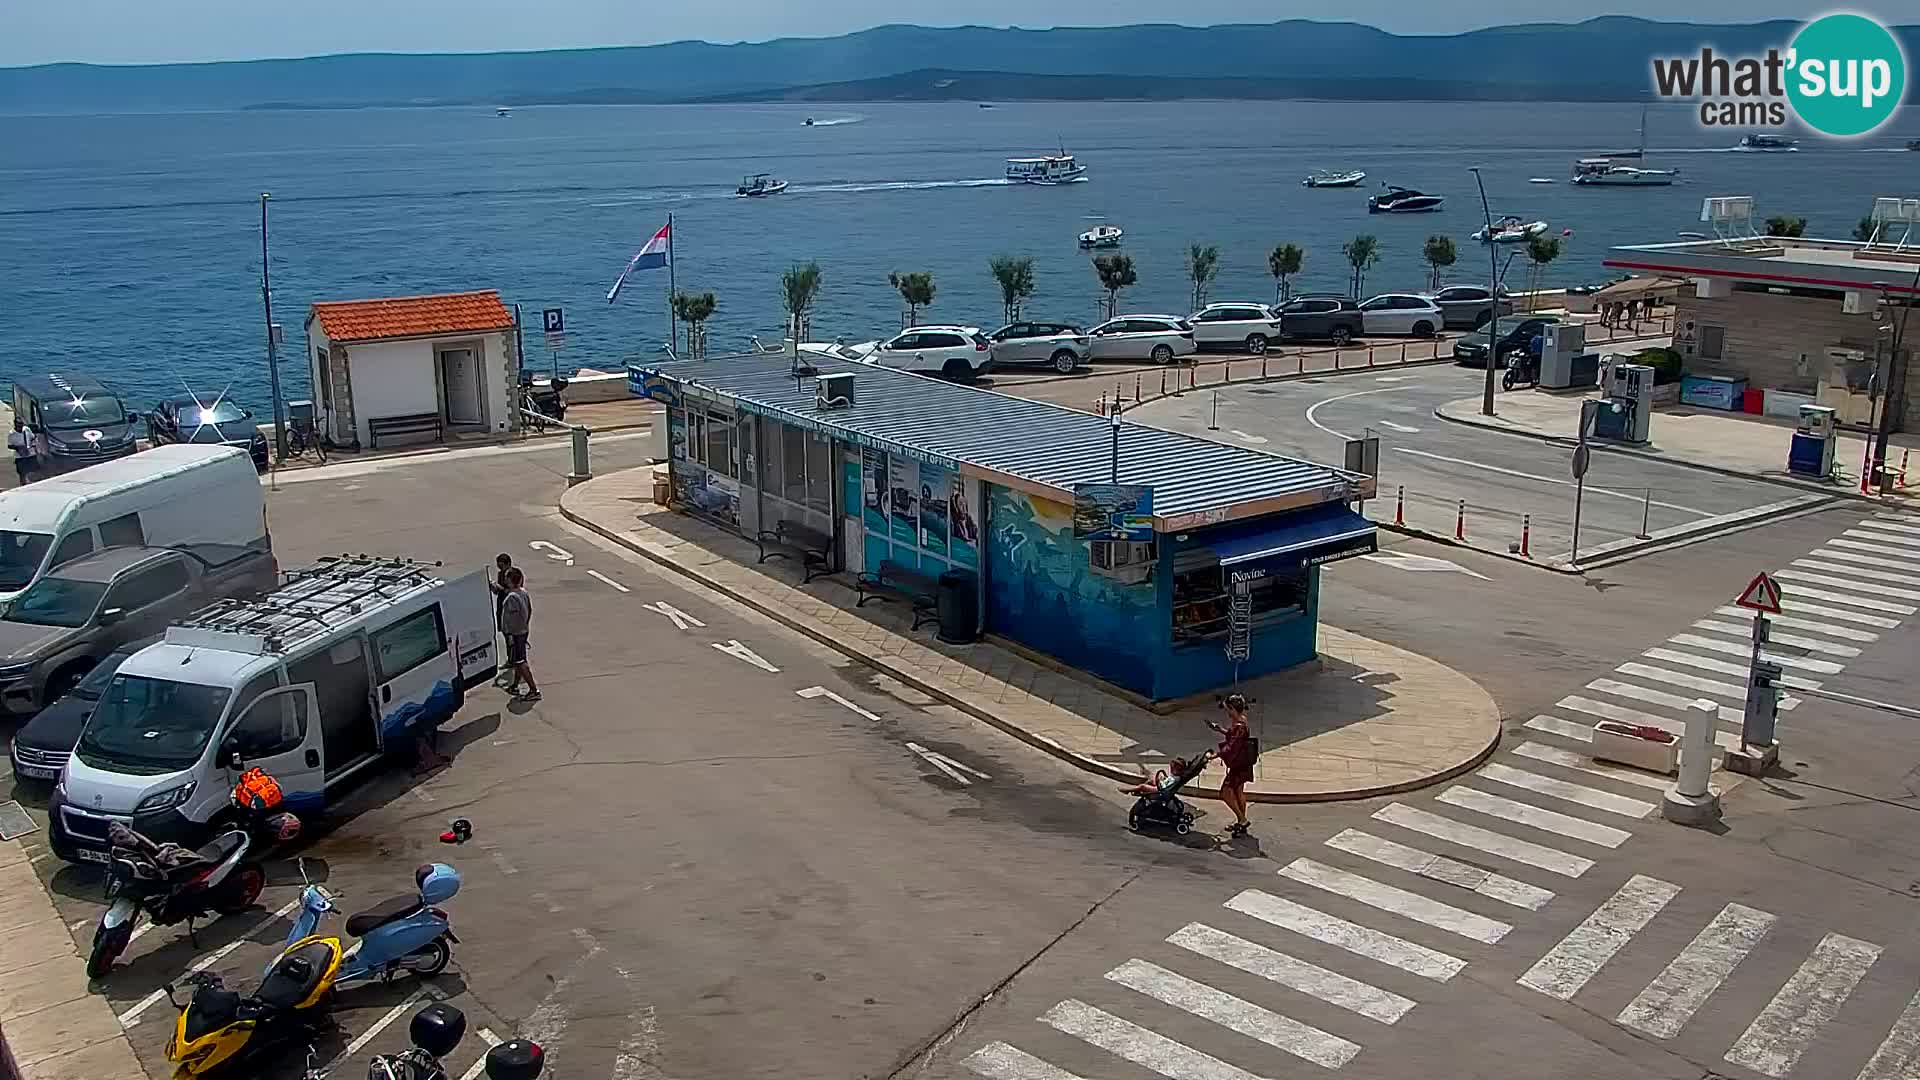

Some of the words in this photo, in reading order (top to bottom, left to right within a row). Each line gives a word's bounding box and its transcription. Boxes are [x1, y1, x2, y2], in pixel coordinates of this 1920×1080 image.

[548, 312, 558, 328] P
[857, 432, 871, 445] BUS
[872, 438, 902, 455] STATION
[904, 447, 928, 462] TICKET
[929, 455, 955, 470] OFFICE
[1231, 568, 1266, 584] Novine
